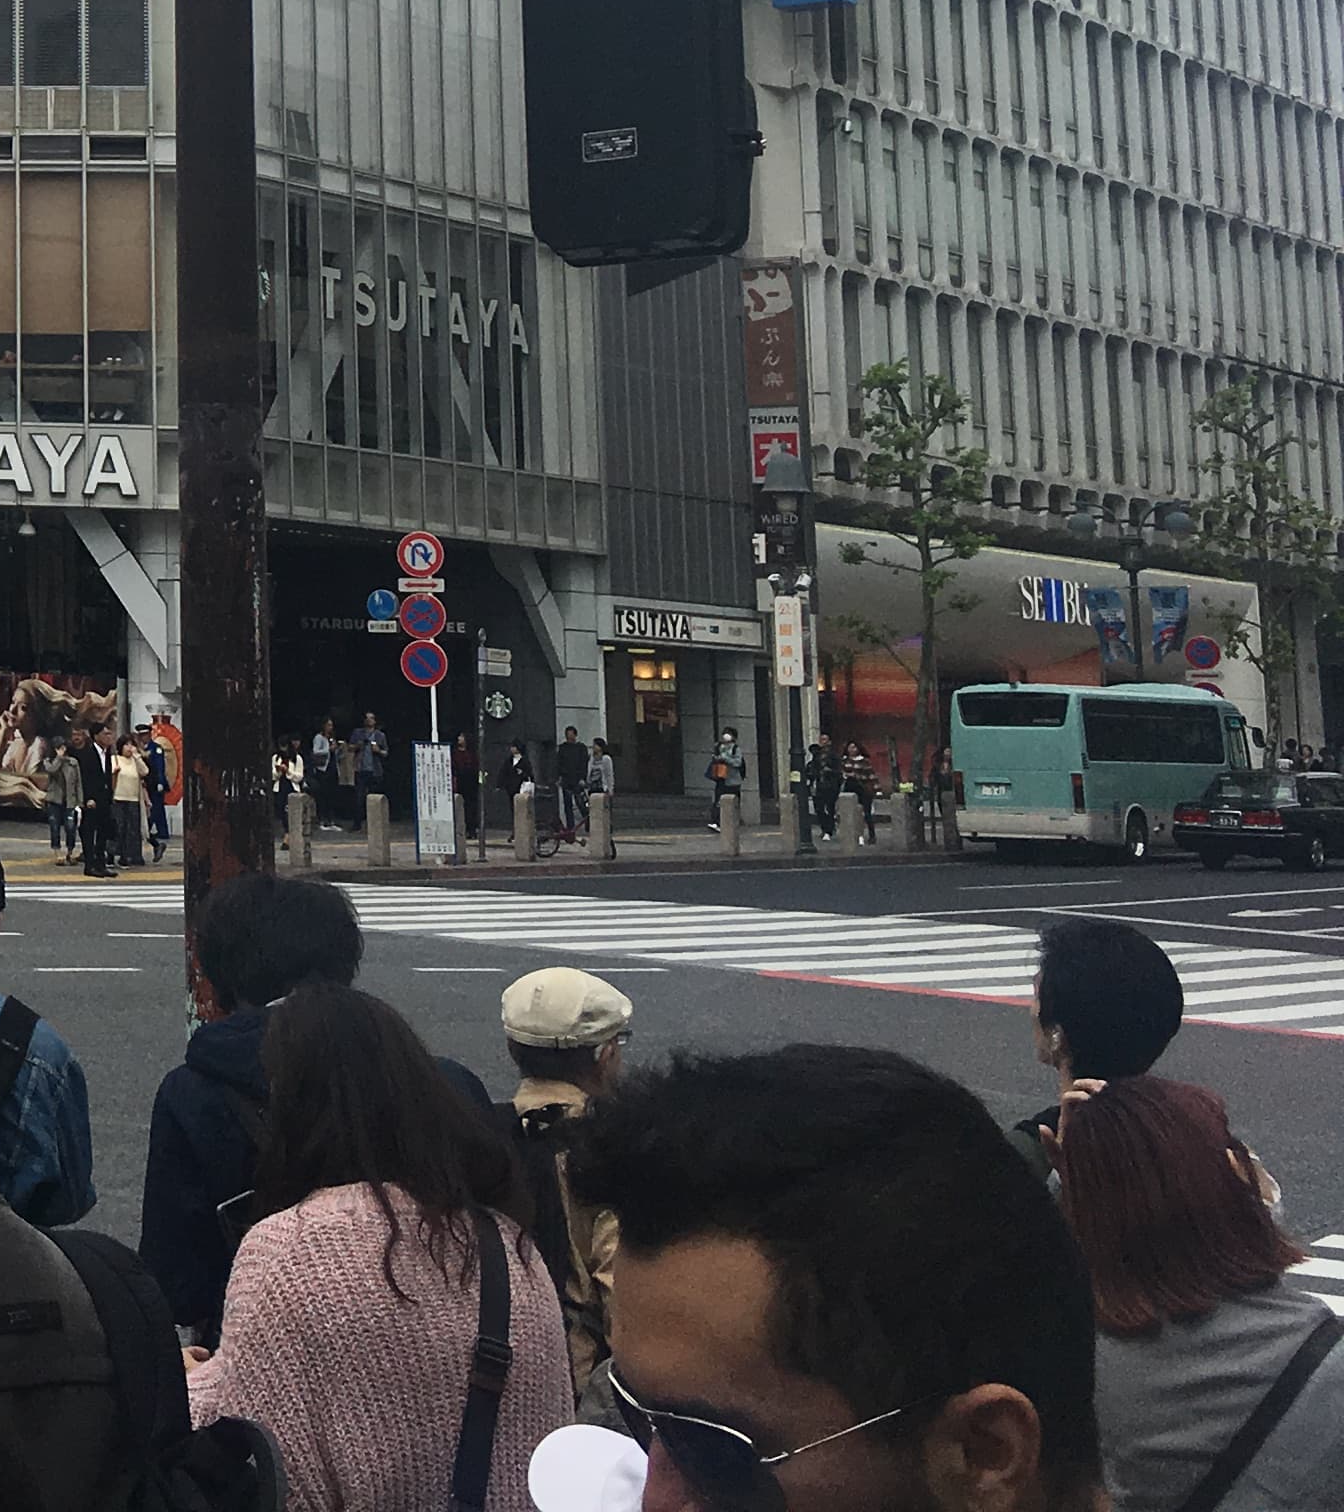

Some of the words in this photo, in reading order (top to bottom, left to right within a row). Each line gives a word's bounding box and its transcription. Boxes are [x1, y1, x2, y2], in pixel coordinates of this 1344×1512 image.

[322, 266, 530, 355] TSUTAYA
[750, 415, 800, 425] TSUTAYA
[1019, 575, 1092, 626] SEIBU
[615, 609, 691, 639] TSUTAYA
